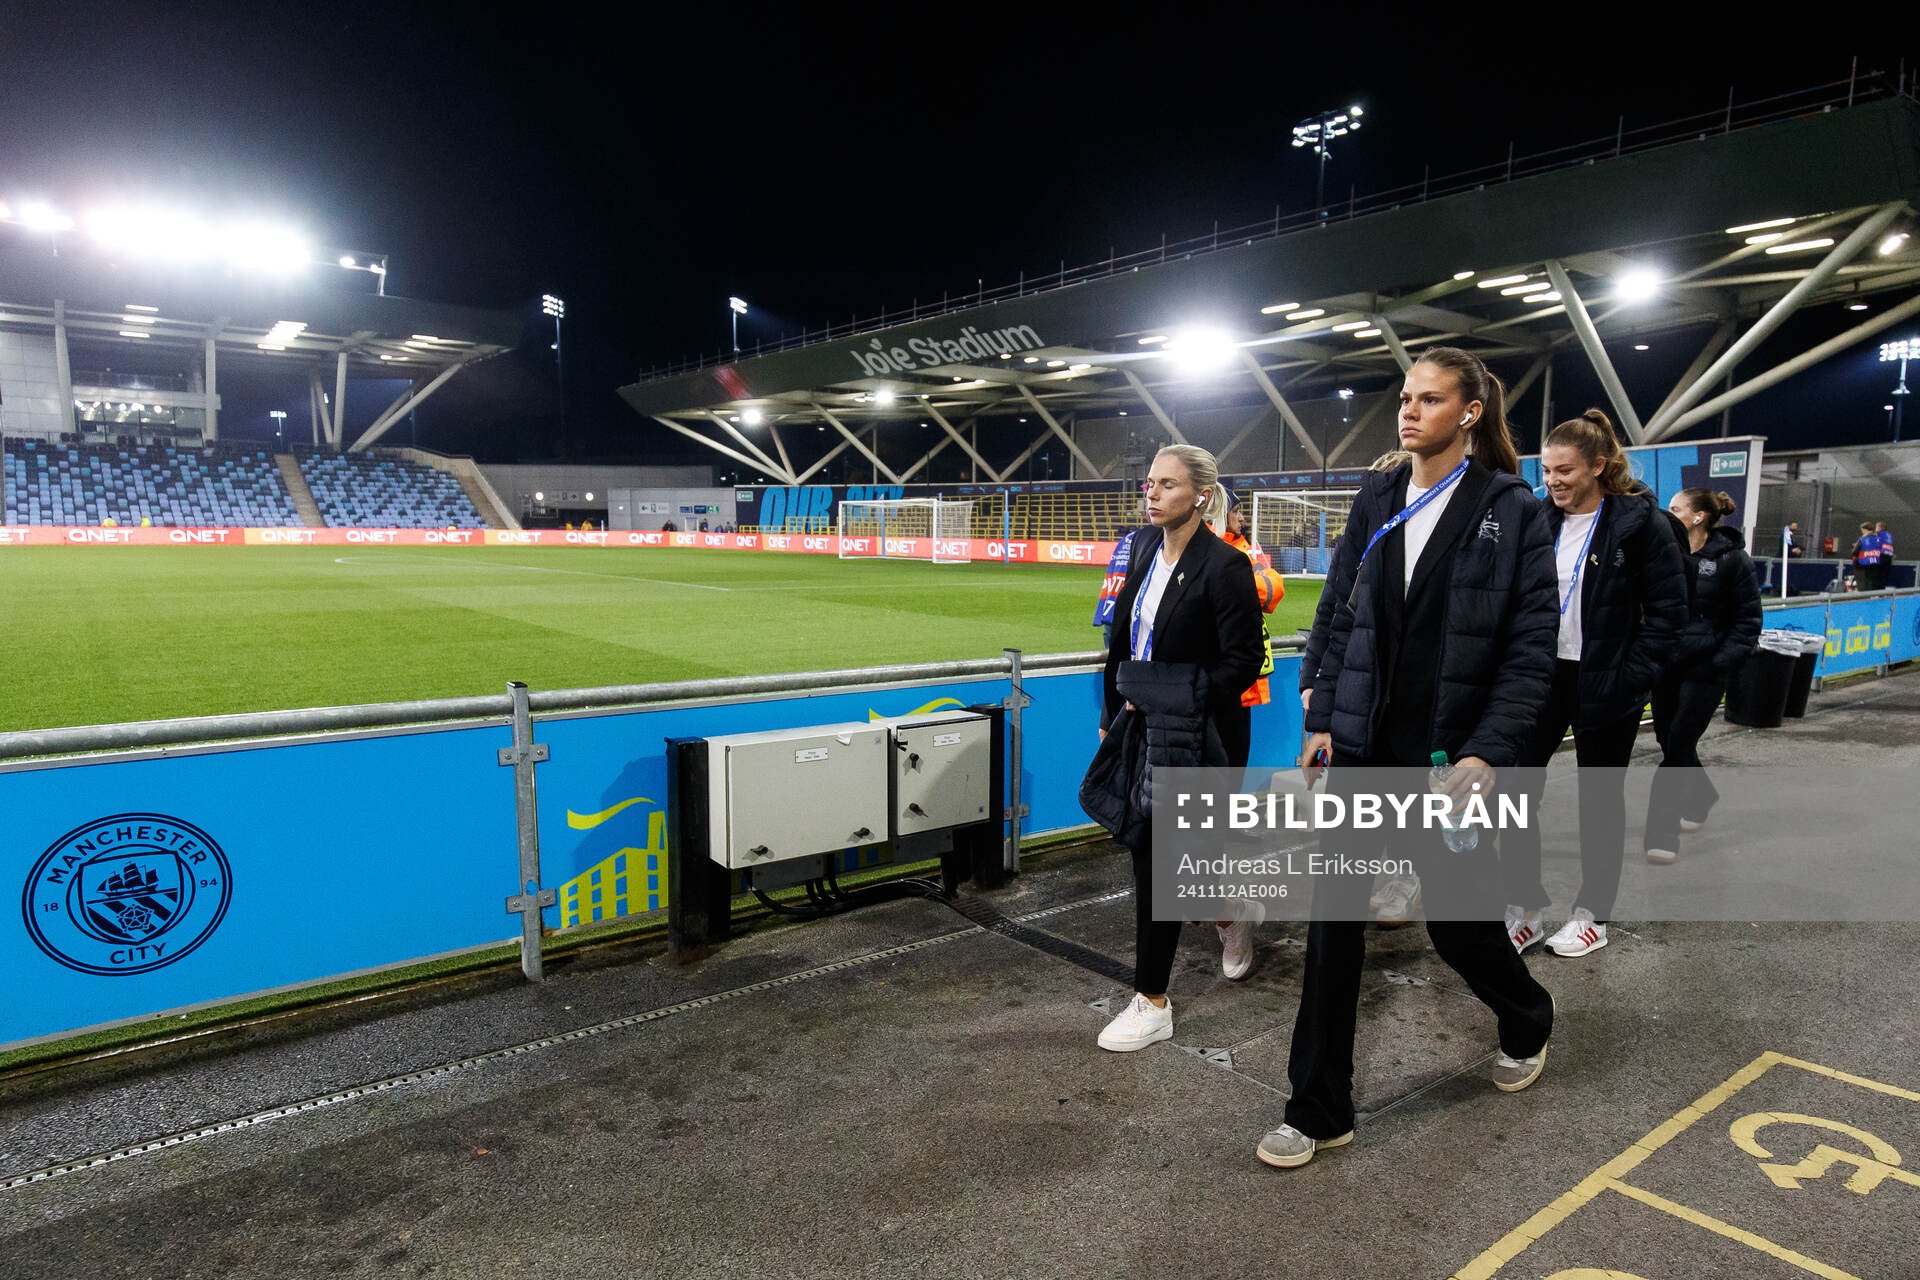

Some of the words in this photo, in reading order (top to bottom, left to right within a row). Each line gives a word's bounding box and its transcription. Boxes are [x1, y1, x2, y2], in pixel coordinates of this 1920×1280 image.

[851, 338, 917, 377] Joie
[908, 324, 1045, 366] Stadium
[759, 486, 833, 534] OUR
[0, 528, 30, 542] ET
[68, 529, 134, 542] QNET
[169, 530, 229, 542] QNET
[261, 530, 317, 542] QNET
[346, 530, 398, 543] QNET
[424, 531, 472, 543] QNET
[497, 531, 542, 543] QNET
[566, 531, 608, 543] QNET
[628, 532, 663, 544] QNET
[676, 533, 697, 545] QNET
[705, 534, 726, 546] QNET
[736, 535, 757, 547] QNET
[768, 536, 791, 548] QNET
[804, 537, 829, 549] QNET
[842, 538, 870, 552] QNET
[884, 540, 917, 553] QNET
[987, 542, 1027, 558] QNET
[1050, 543, 1095, 561] QNET
[47, 826, 208, 884] MANCHESTER
[200, 878, 218, 888] 94
[42, 903, 59, 912] 18
[109, 942, 167, 965] CITY
